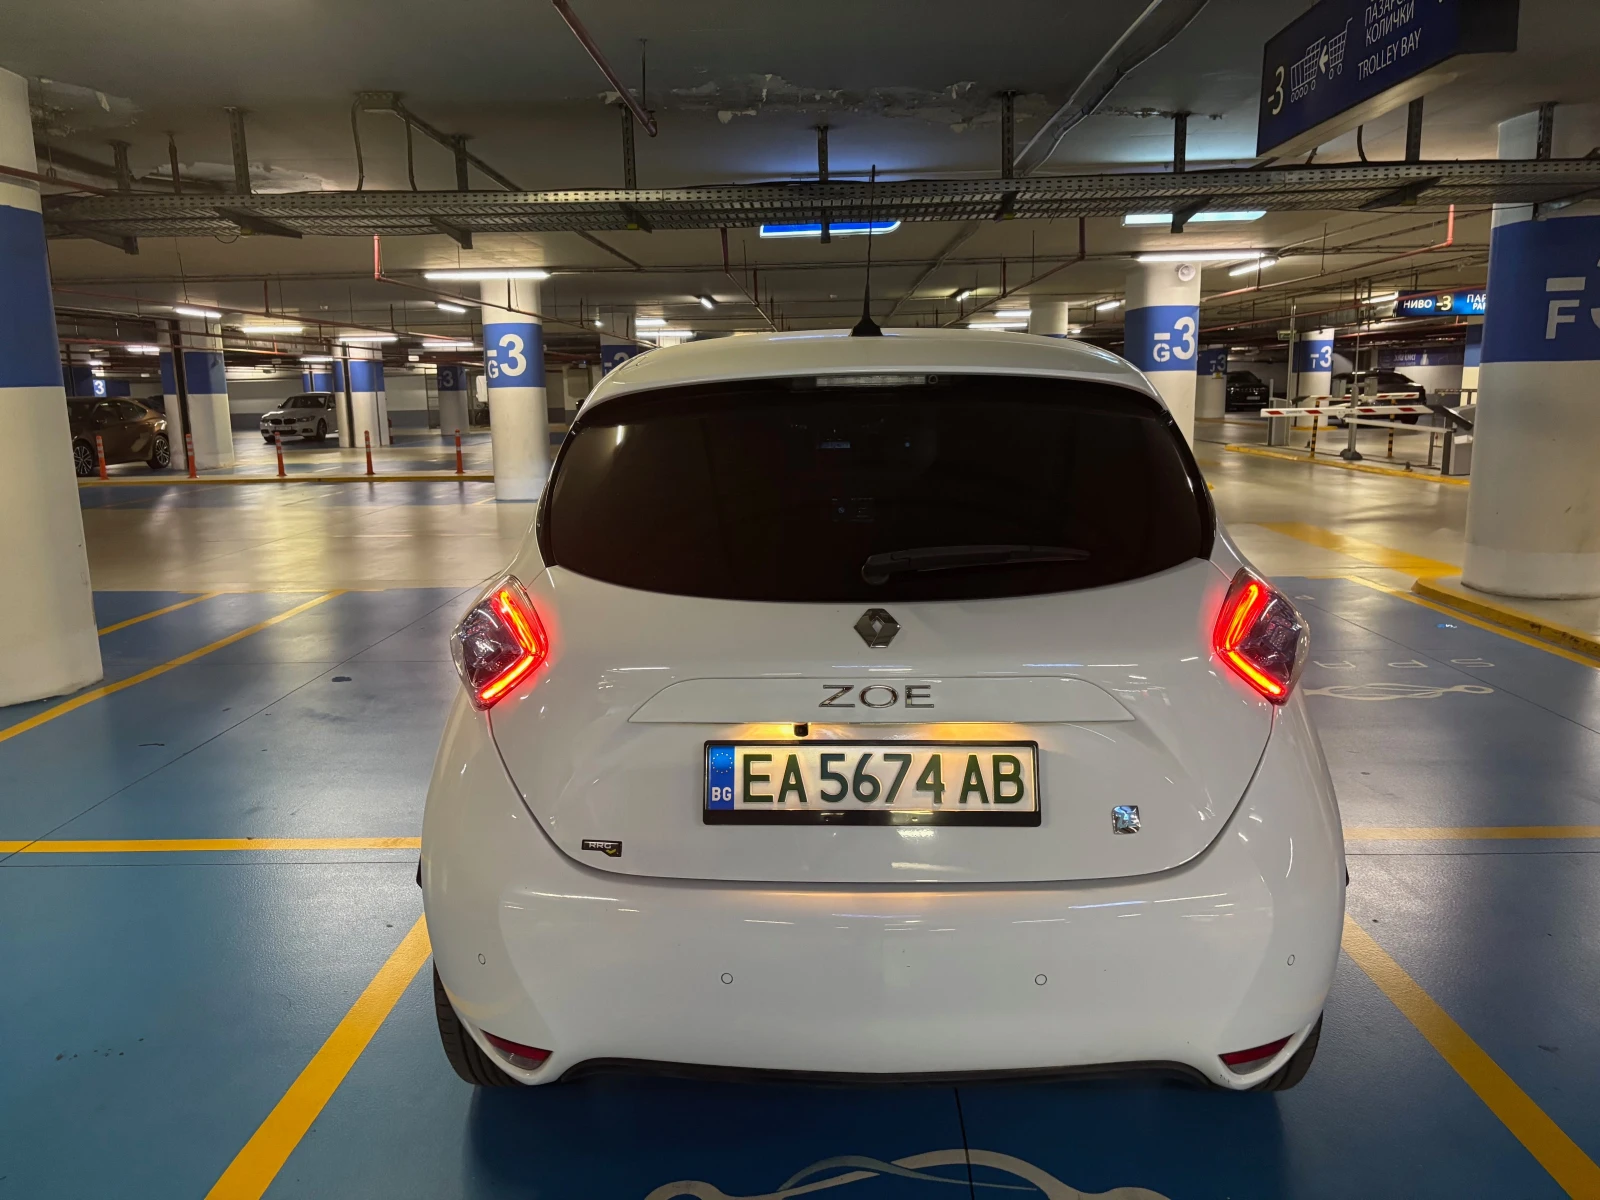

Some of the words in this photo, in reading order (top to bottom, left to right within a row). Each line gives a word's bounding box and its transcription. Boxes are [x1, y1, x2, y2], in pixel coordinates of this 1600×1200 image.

[1366, 0, 1416, 47] КОЛИЧКИ
[1357, 40, 1400, 81] TROLLEY
[1400, 27, 1422, 57] BAY
[1403, 299, 1433, 309] НИВО
[1435, 295, 1452, 311] -3
[94, 380, 105, 395] 3
[818, 684, 935, 709] ZOE
[710, 786, 732, 802] BG
